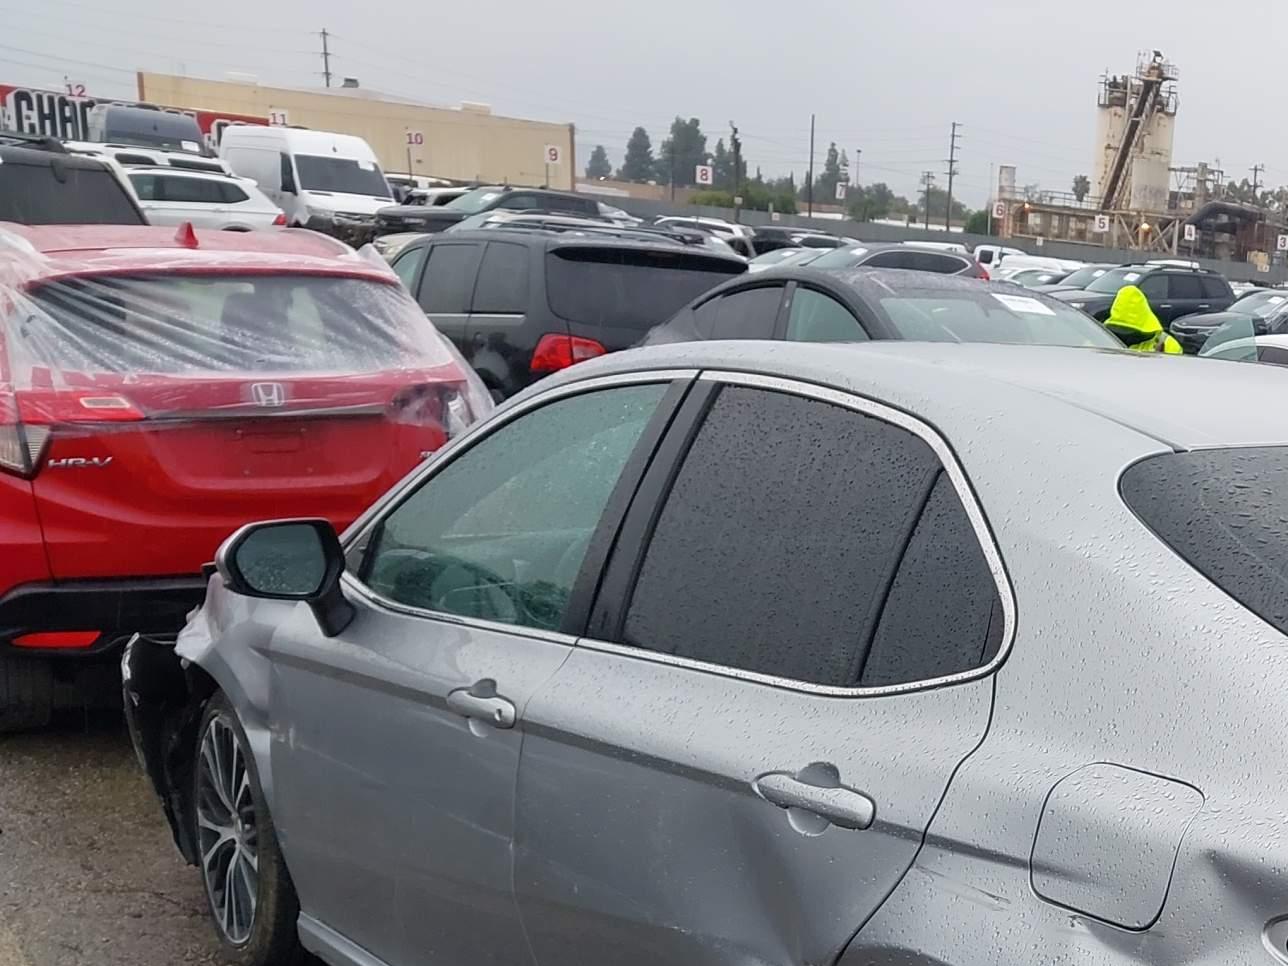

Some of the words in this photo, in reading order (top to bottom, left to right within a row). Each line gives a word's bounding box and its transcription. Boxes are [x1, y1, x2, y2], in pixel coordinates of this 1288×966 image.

[65, 84, 86, 97] 12
[270, 112, 287, 125] 11
[406, 132, 424, 145] 10
[548, 147, 558, 161] 9
[699, 168, 708, 181] 8
[837, 184, 846, 198] 7
[995, 203, 1005, 217] 6
[1099, 217, 1106, 229] 5
[1186, 226, 1194, 238] 4
[1279, 237, 1287, 248] 3
[48, 456, 113, 468] HR-V
